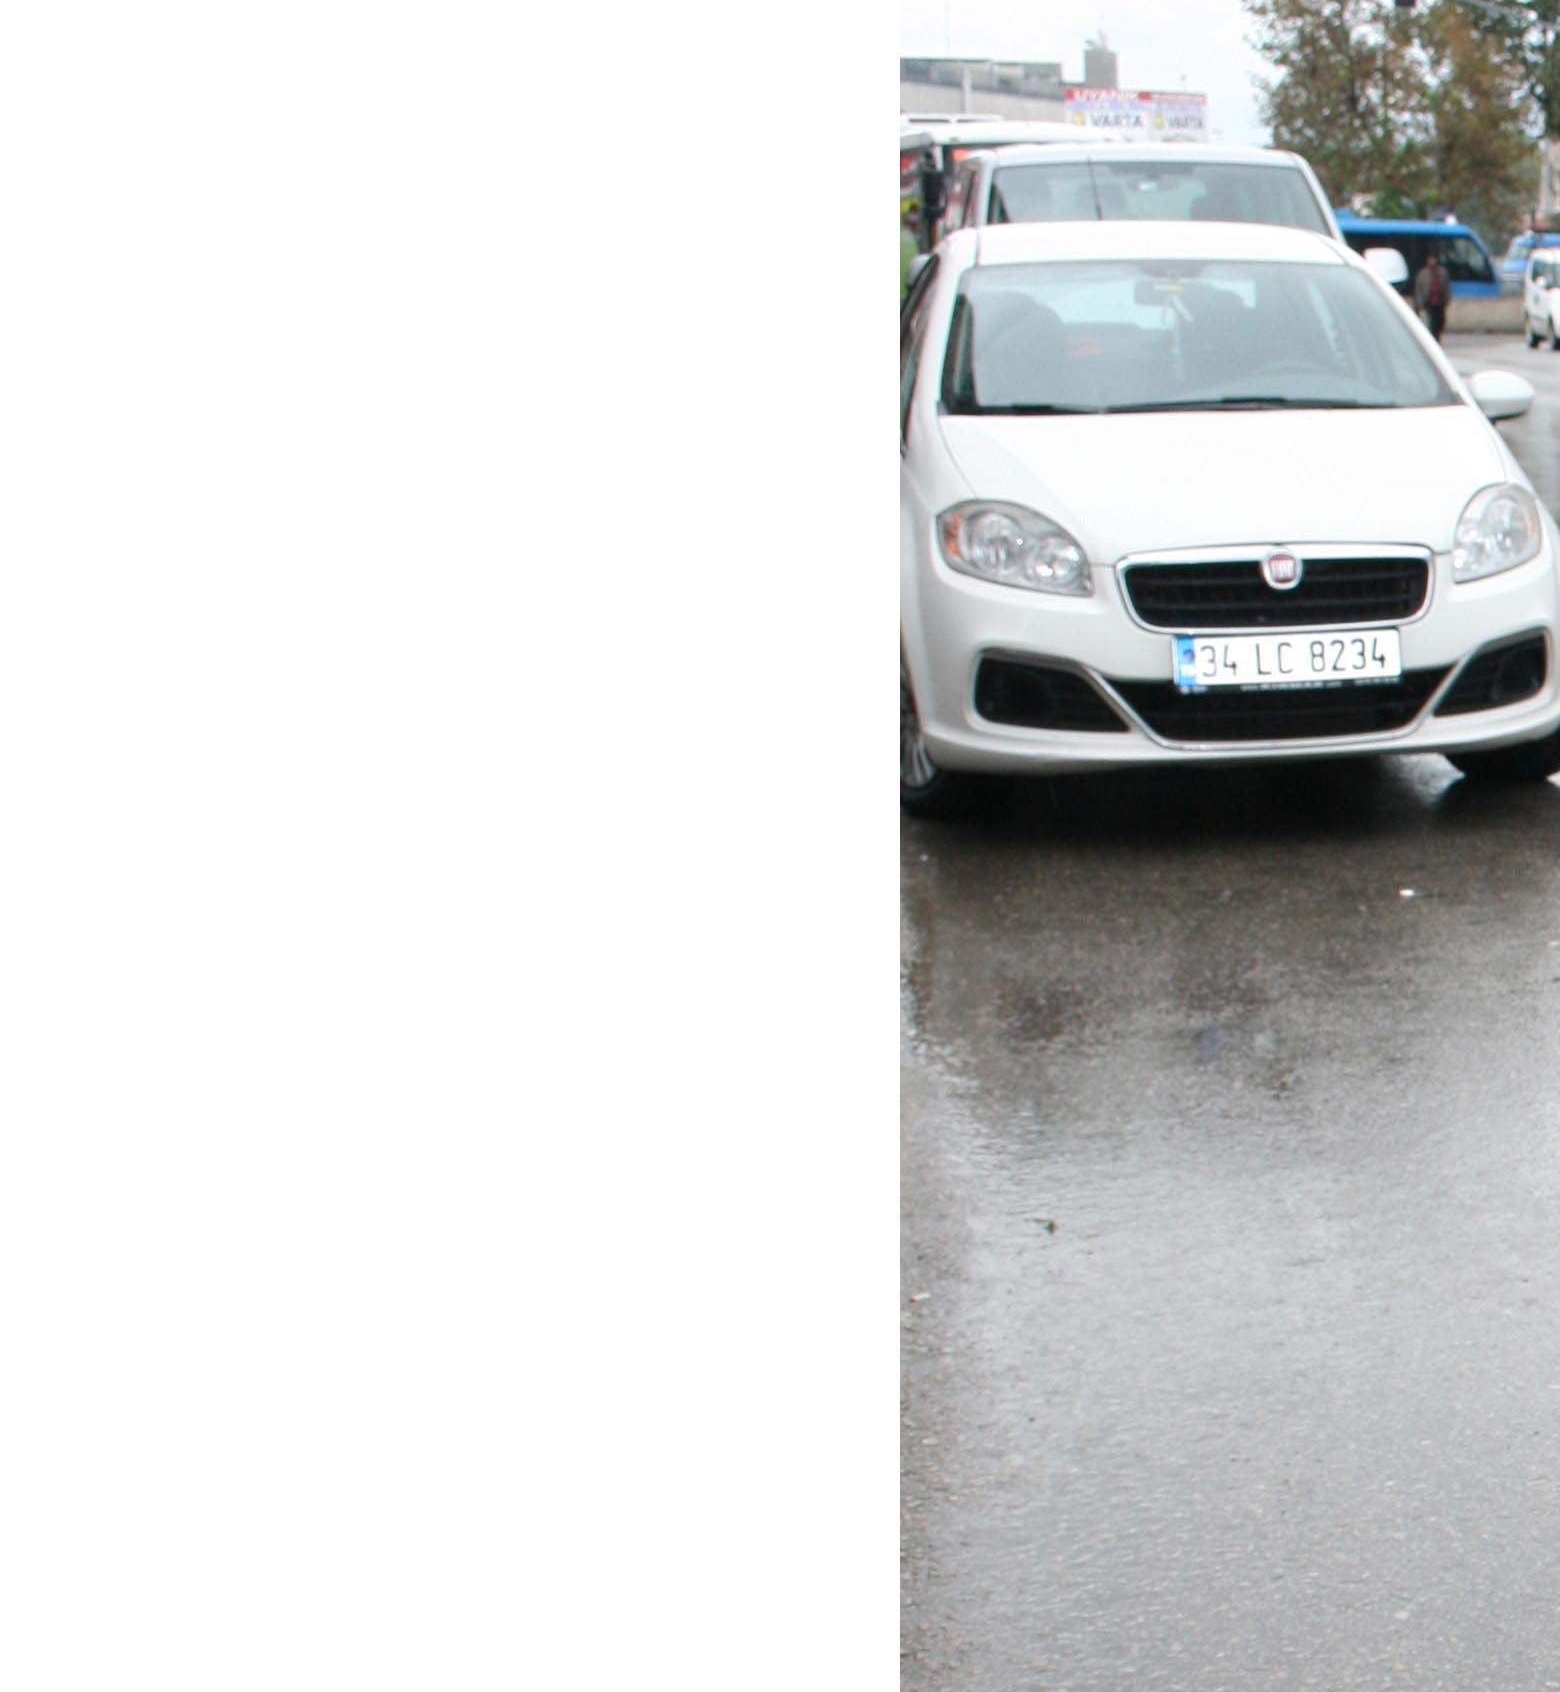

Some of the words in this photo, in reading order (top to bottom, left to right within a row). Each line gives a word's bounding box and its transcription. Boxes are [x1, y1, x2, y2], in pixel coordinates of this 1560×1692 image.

[1200, 644, 1237, 678] 34
[1255, 641, 1293, 676] LC
[1310, 637, 1386, 673] 8234
